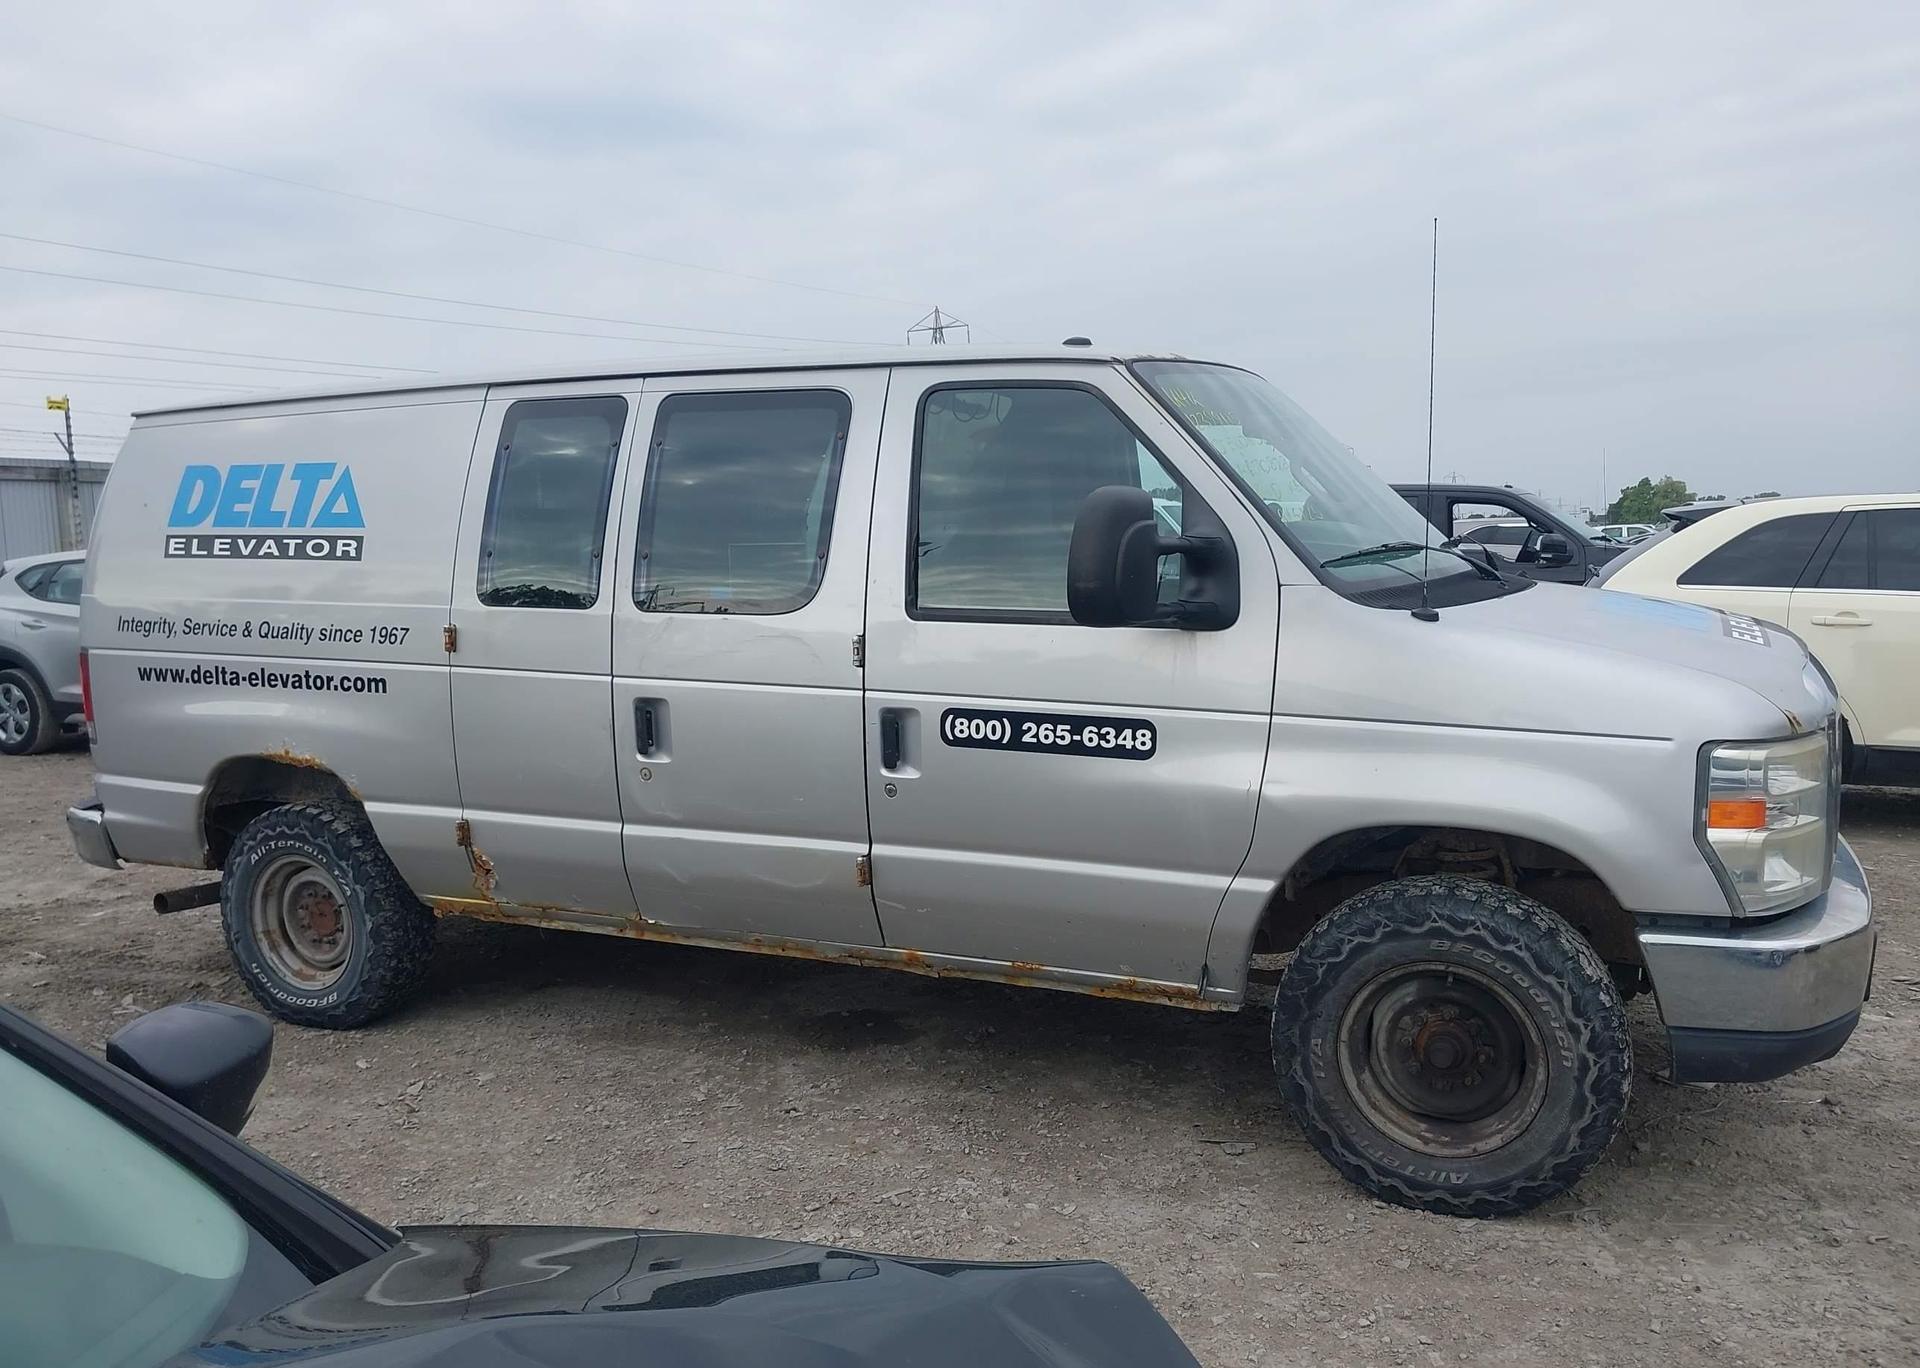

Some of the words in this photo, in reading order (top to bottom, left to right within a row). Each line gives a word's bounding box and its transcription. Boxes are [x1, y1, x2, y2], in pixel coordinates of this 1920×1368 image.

[167, 461, 366, 529] DELTA
[167, 536, 359, 558] ELEVATOR
[117, 615, 178, 638] Integrity,
[182, 617, 238, 638] Service
[241, 620, 253, 638] &
[258, 620, 315, 645] Quality
[318, 623, 364, 645] since
[369, 625, 410, 646] 1967
[137, 664, 388, 694] www.delta-elevator.com
[944, 714, 1012, 744] (800)
[1021, 721, 1153, 751] 265-6348
